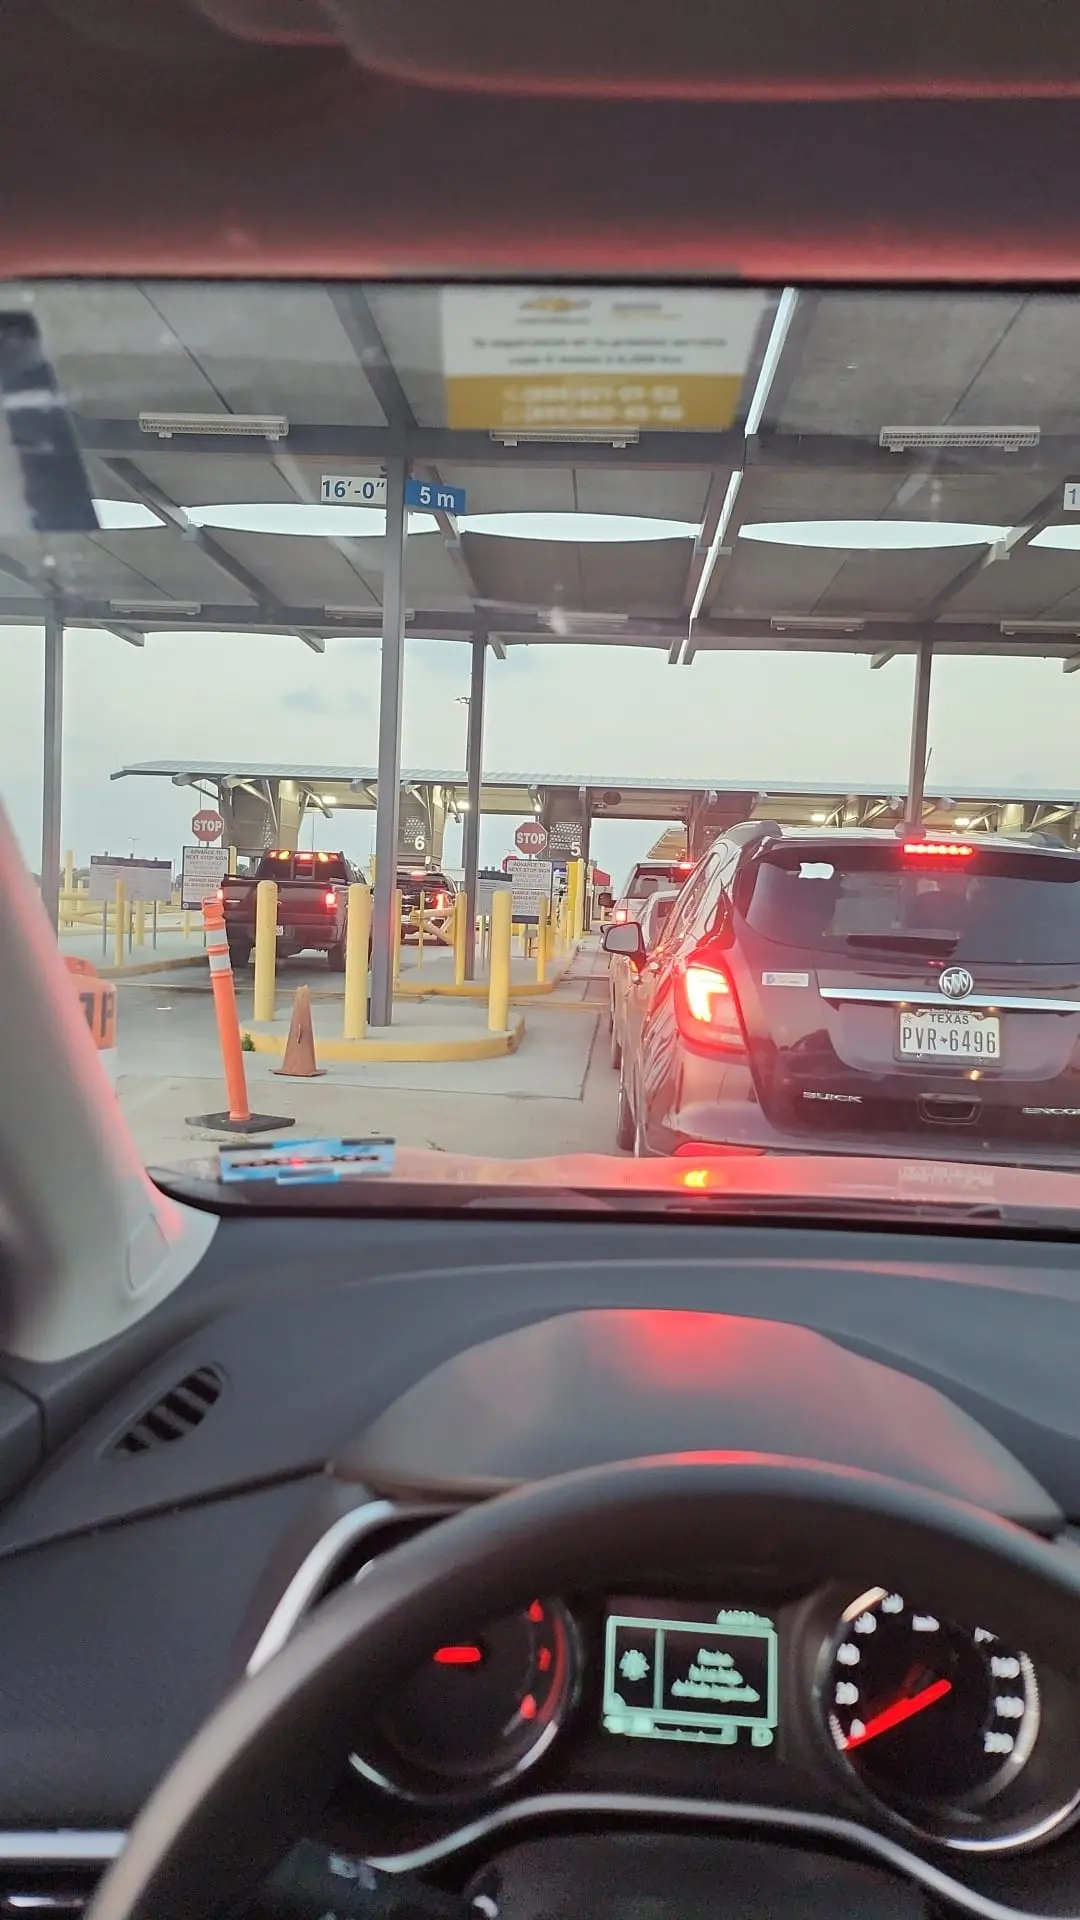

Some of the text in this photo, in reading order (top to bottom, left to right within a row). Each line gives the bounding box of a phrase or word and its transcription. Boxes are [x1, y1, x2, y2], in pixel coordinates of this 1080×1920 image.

[420, 486, 454, 508] 5 m
[193, 819, 222, 832] STOP
[415, 835, 425, 851] 6
[516, 832, 546, 844] STOP
[570, 841, 581, 856] 5
[930, 1013, 969, 1025] TEXAS
[803, 1091, 863, 1103] BUICK
